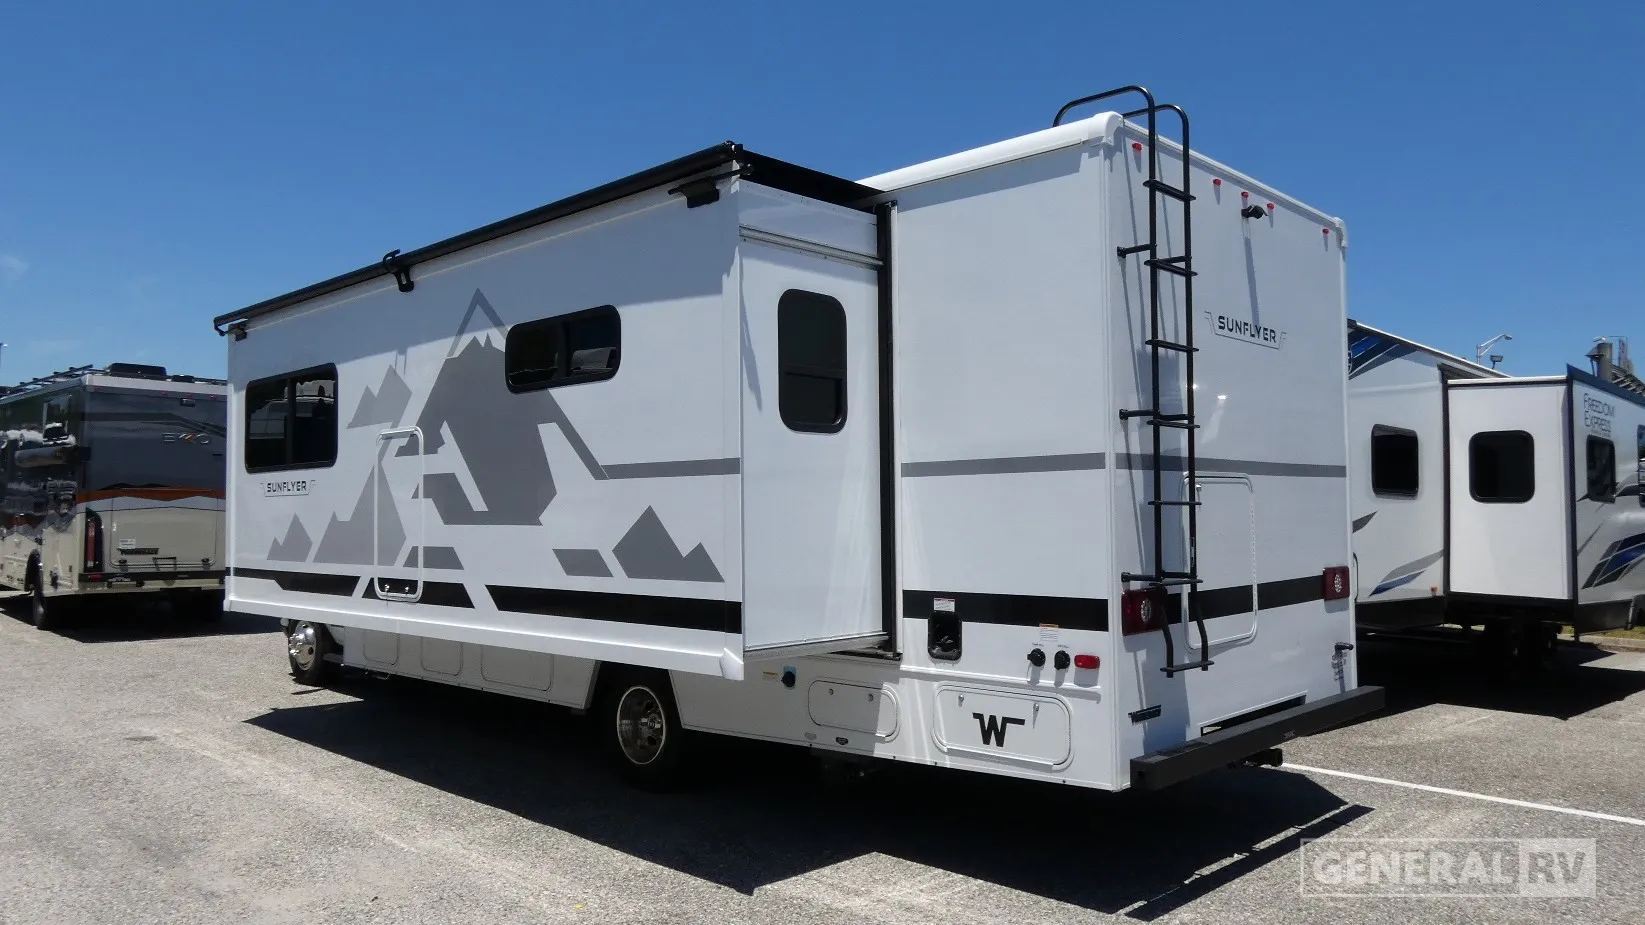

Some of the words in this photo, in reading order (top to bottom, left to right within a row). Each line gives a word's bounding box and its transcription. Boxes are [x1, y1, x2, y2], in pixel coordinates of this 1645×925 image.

[1218, 315, 1277, 343] SUNFLYER
[1584, 392, 1615, 417] FREEDOM
[1584, 410, 1612, 432] EXPRESS
[266, 480, 307, 493] SUNFLYER
